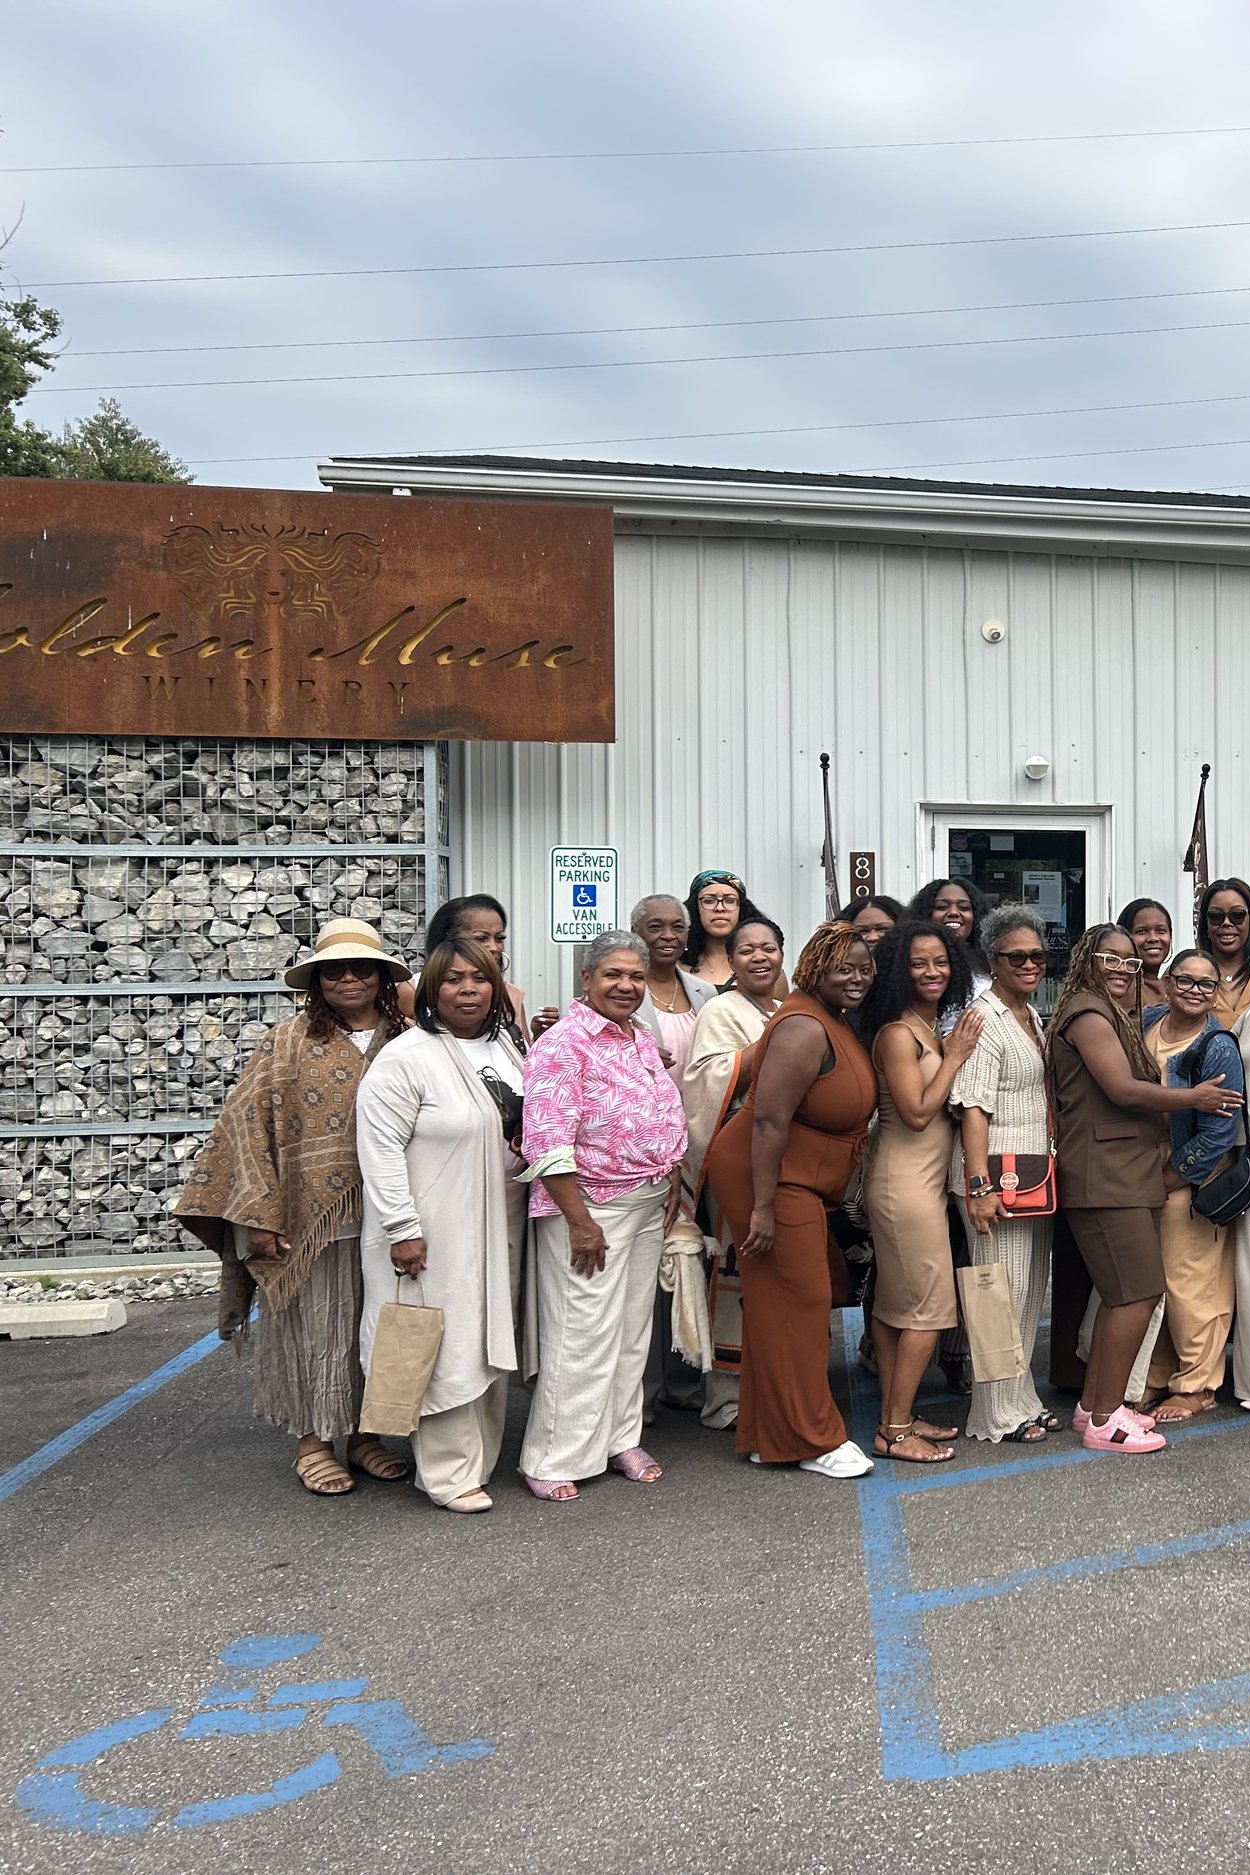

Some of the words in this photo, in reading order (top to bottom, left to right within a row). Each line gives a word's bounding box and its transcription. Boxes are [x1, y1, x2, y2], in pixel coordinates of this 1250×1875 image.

[0, 582, 273, 660] olden
[308, 597, 588, 669] Muse
[142, 675, 410, 705] WINERY
[555, 855, 614, 868] RESERVED
[559, 870, 611, 883] PARKING
[572, 909, 598, 921] VAN
